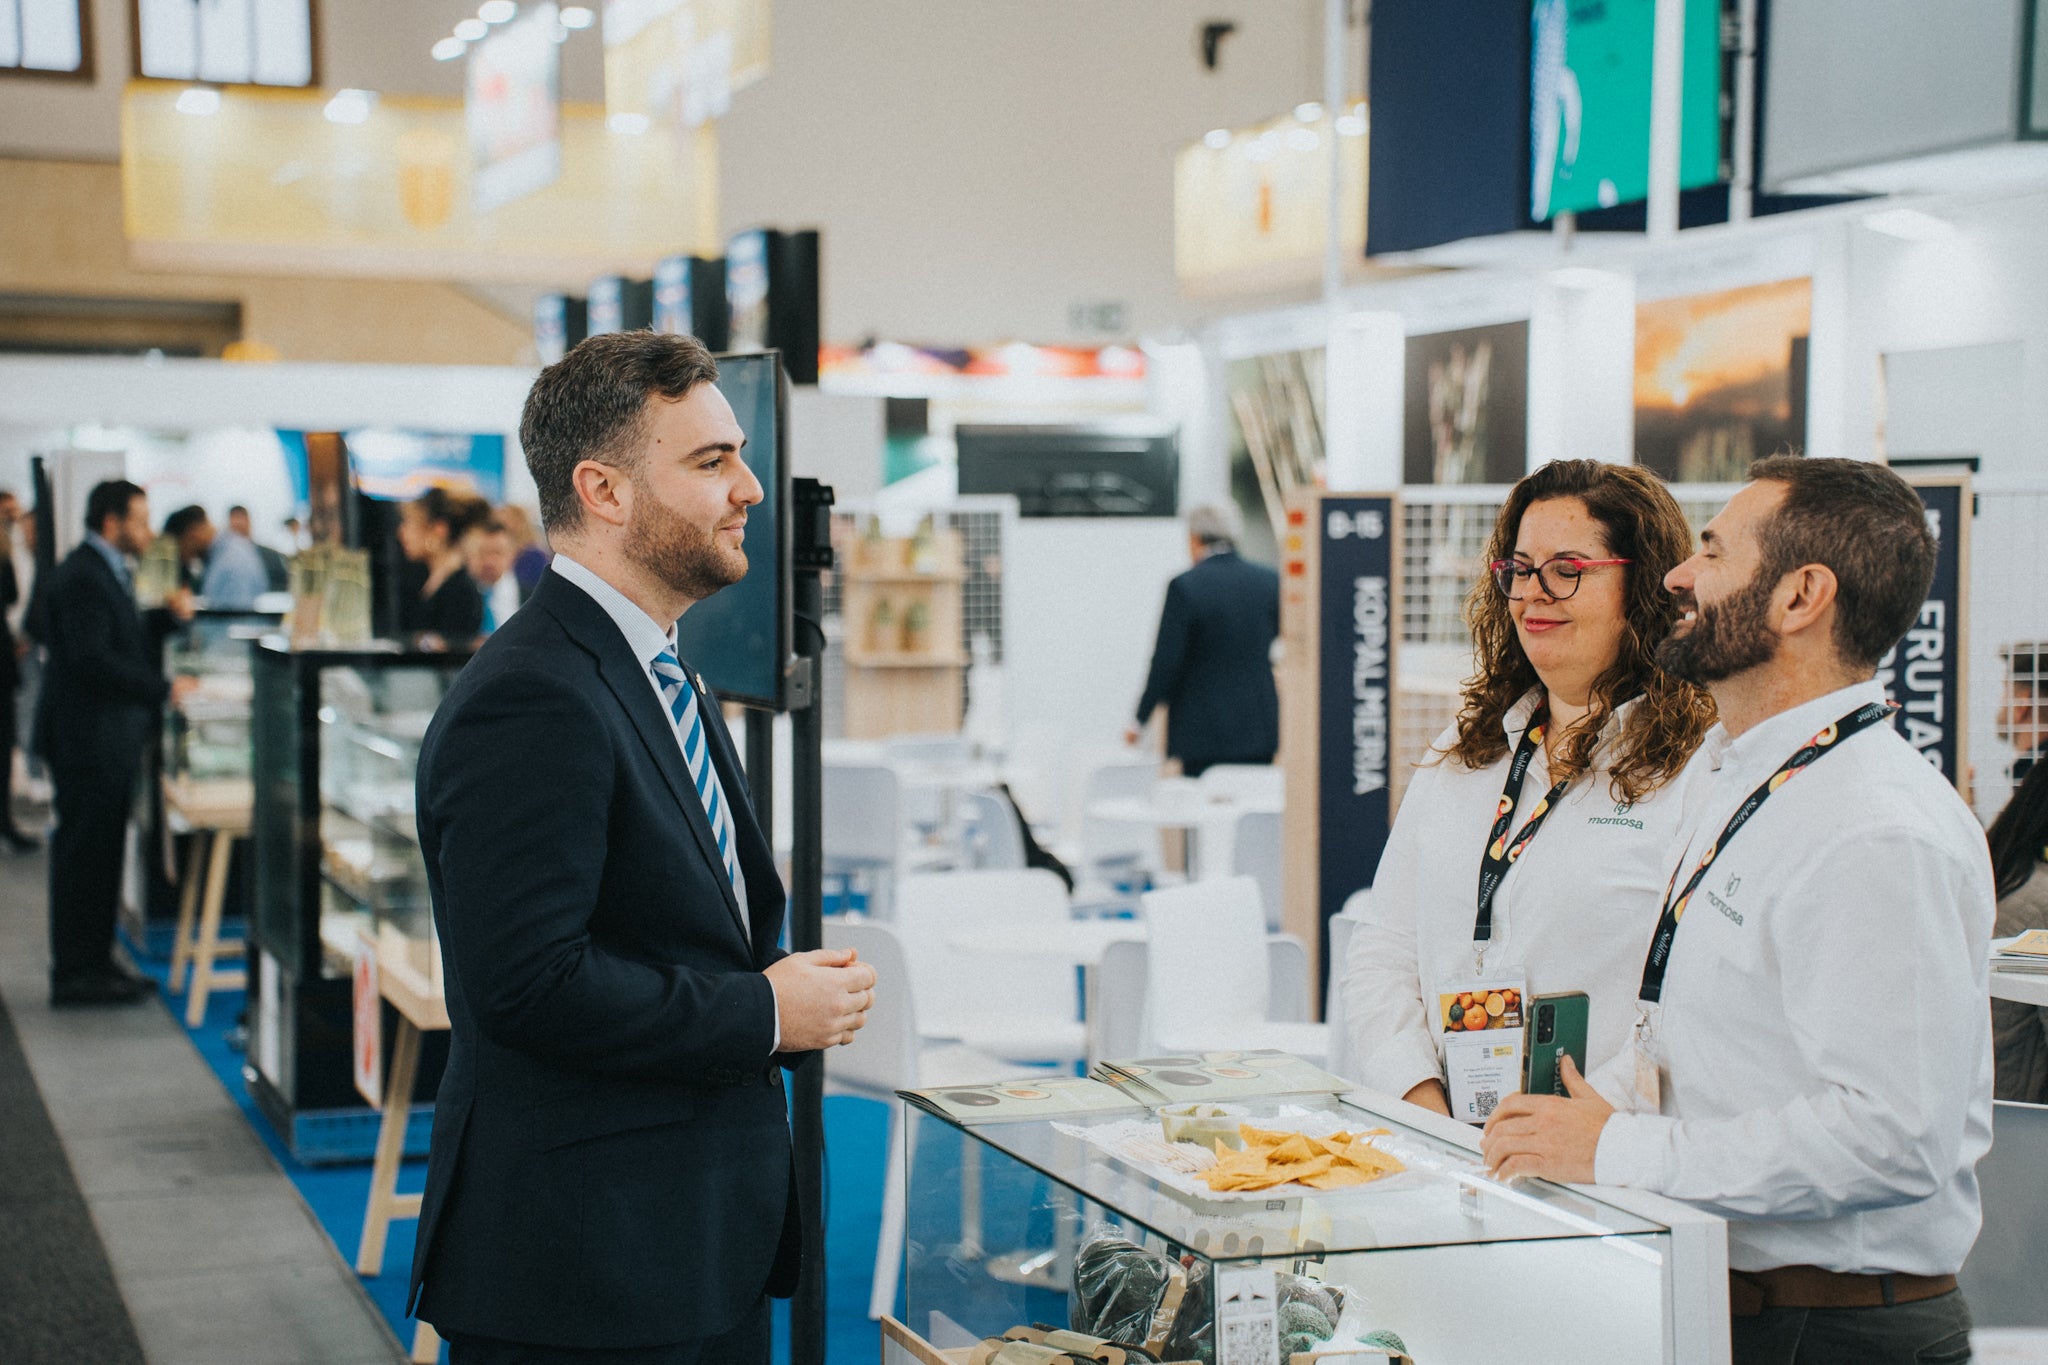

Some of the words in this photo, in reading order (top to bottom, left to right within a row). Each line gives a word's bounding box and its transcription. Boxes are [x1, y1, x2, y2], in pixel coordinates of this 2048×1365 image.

[1353, 576, 1387, 795] KOPALMERIA
[1512, 750, 1530, 782] Sublime
[1588, 817, 1643, 830] montosa
[1728, 797, 1758, 833] Sublime
[1705, 890, 1744, 926] montosa
[1653, 929, 1670, 967] Sublime
[1554, 1046, 1565, 1096] ontosa
